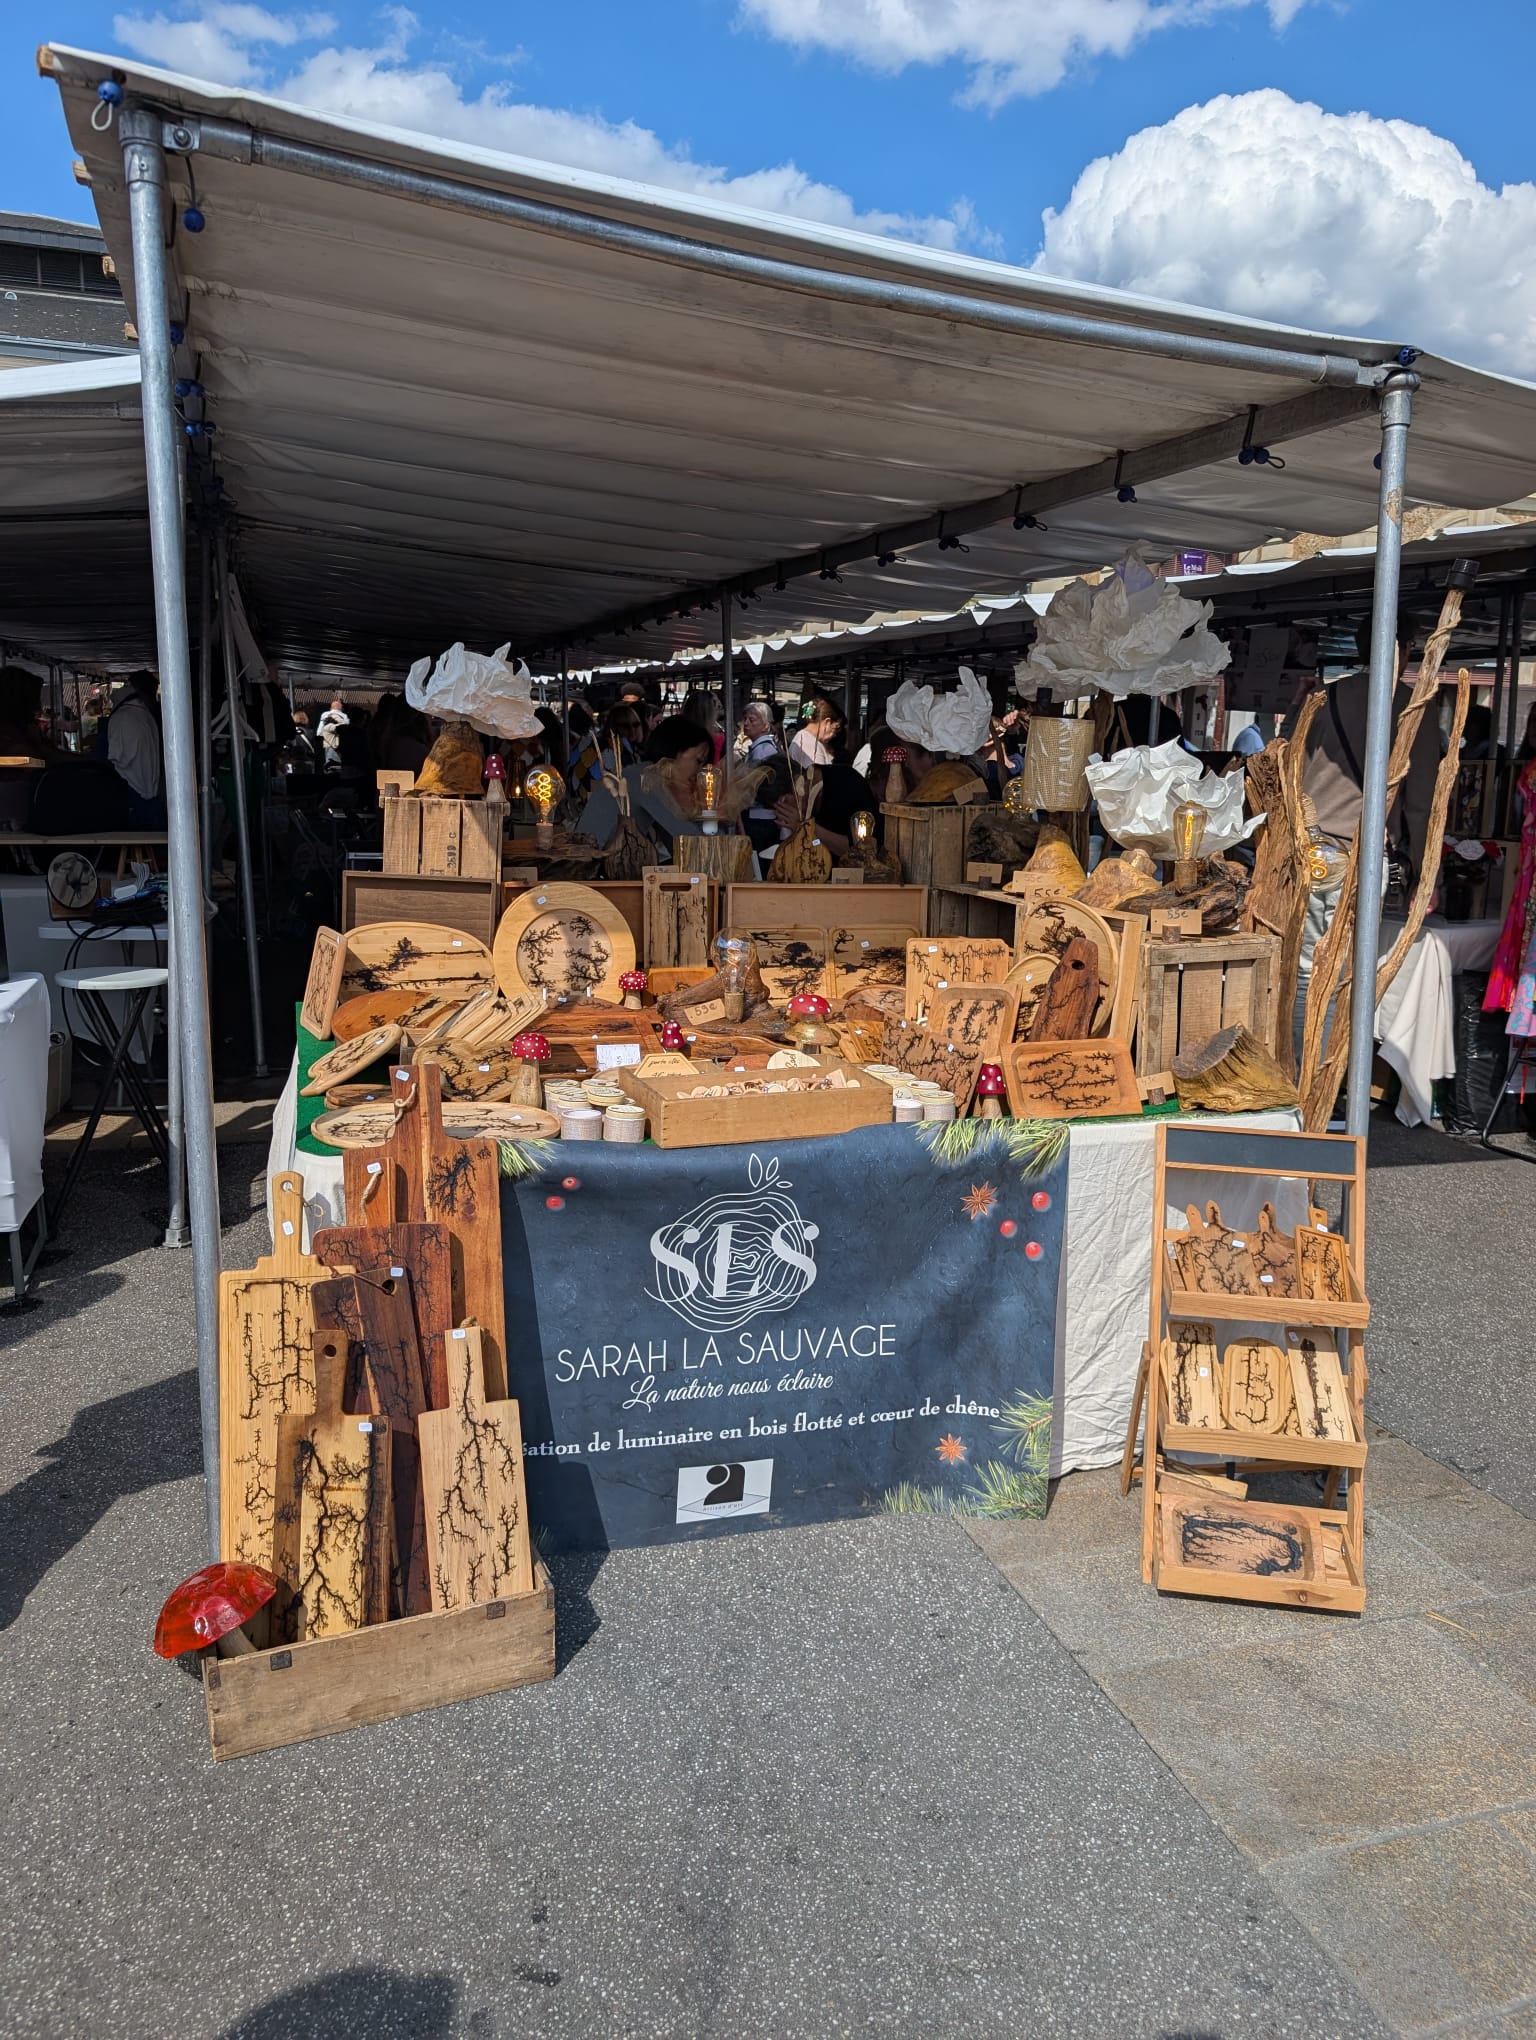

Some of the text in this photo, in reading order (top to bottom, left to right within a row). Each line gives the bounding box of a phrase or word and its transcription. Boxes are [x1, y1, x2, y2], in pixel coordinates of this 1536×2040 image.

[555, 1324, 897, 1382] SARAH LA SAUVAGE
[622, 1369, 834, 1413] La nature nous éclaire
[521, 1394, 1000, 1457] éation de luminaire en bois flotté et cœur de chêne
